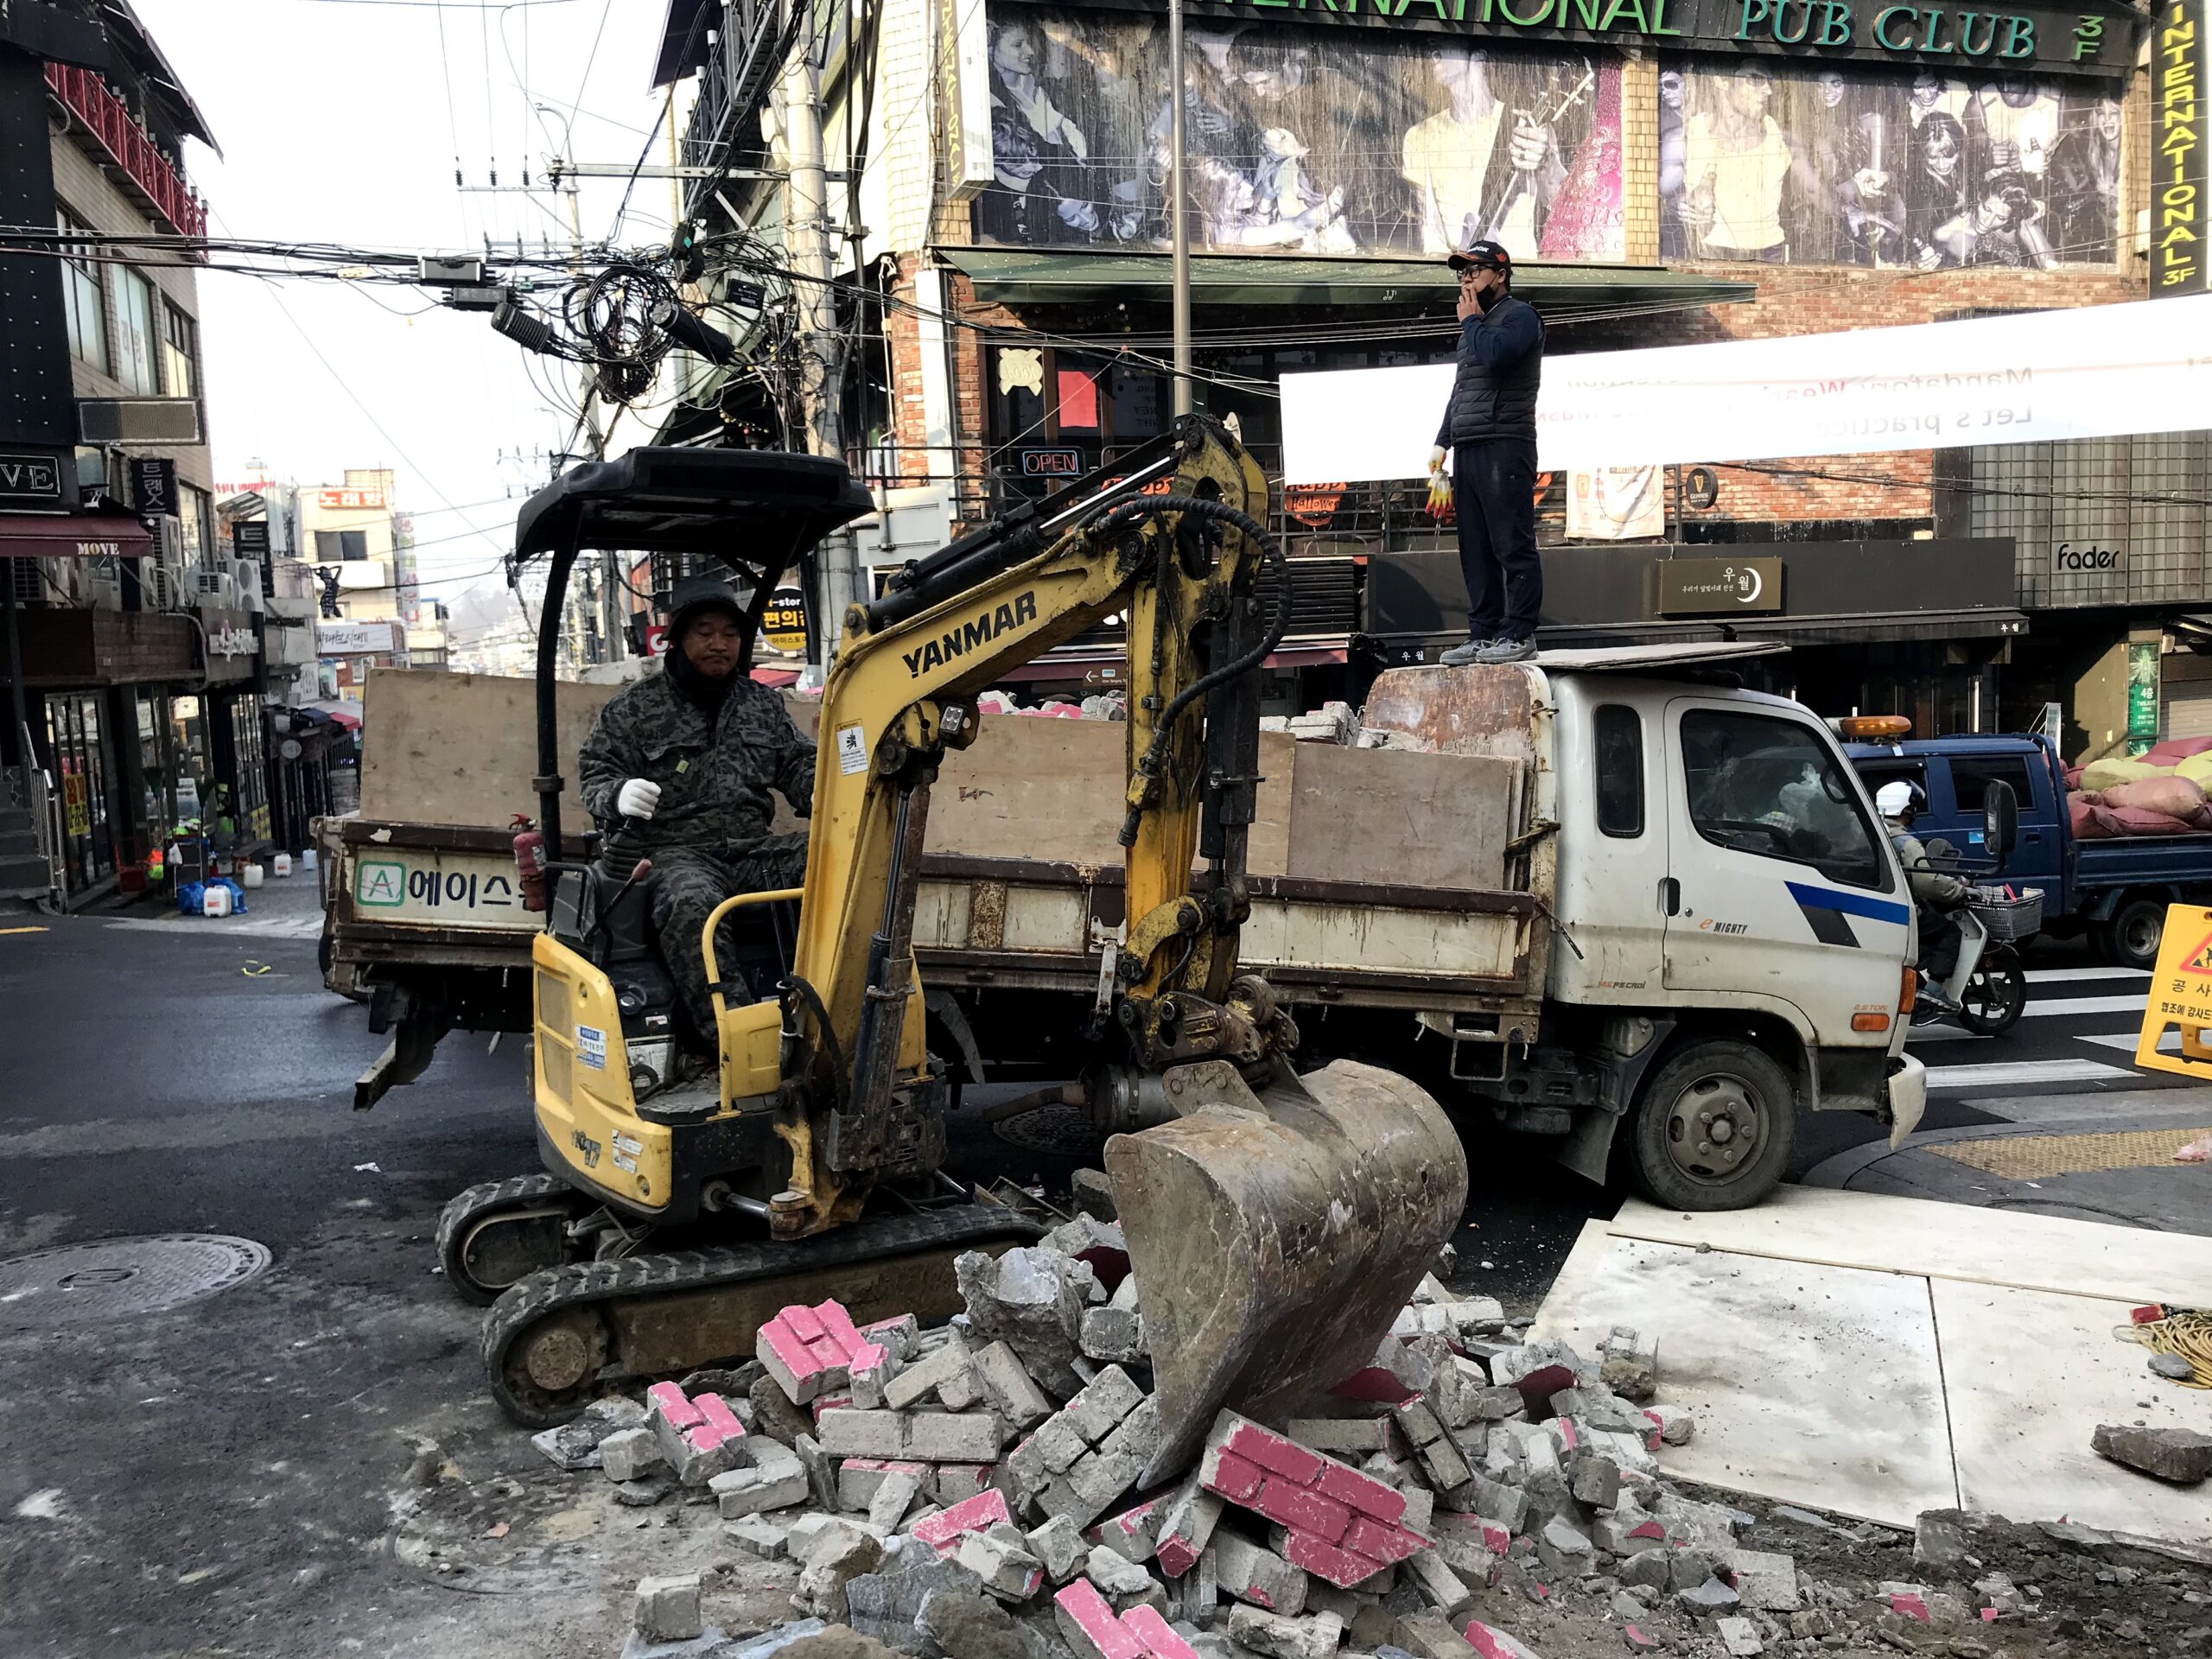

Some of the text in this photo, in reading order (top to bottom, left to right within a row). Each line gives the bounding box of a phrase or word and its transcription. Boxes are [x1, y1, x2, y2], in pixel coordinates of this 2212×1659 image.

[1735, 0, 2036, 59] PUB CLUB
[2160, 4, 2198, 267] INTERNATIONAL
[2162, 266, 2197, 286] 3F
[1026, 454, 1077, 473] OPEN
[76, 543, 120, 556] MOVE
[2058, 543, 2120, 570] fader
[901, 590, 1038, 679] YANMAR
[1713, 922, 1748, 935] MIGHTY
[2161, 1001, 2185, 1016] 협조에
